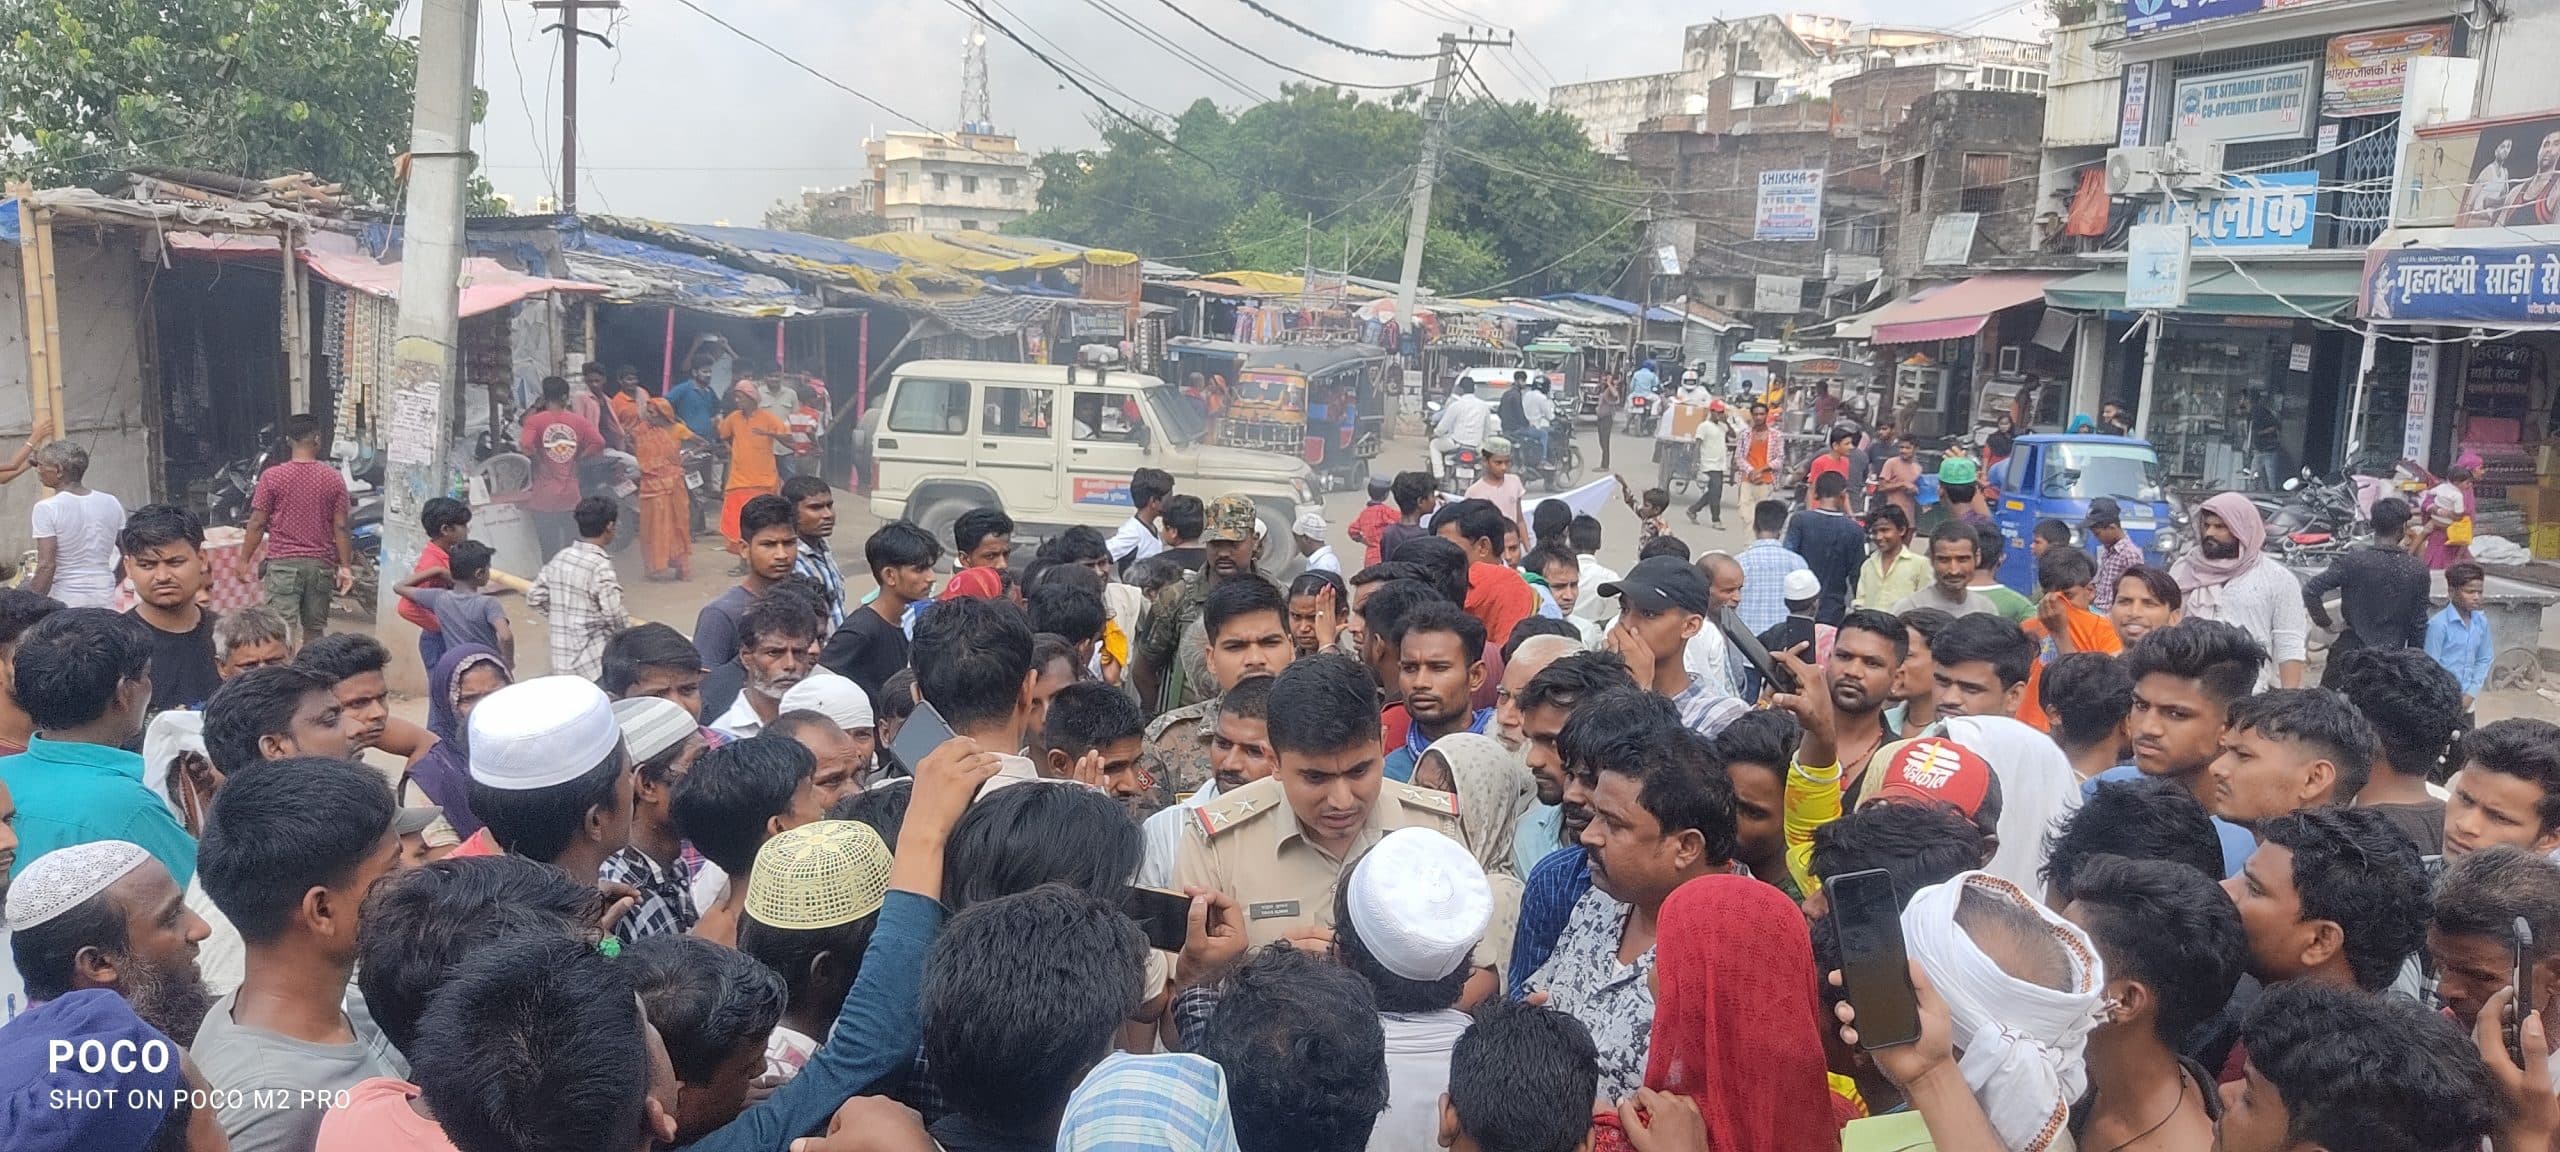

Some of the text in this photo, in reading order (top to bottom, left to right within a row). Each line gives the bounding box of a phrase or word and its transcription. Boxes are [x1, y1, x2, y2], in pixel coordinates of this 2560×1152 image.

[2204, 74, 2303, 100] THE SITAMARHI CENTRAL
[2202, 93, 2300, 119] CO-OPERATIVE BANK LTD.
[1762, 172, 1807, 185] SHIKSHA
[2485, 254, 2534, 304] साड़ी
